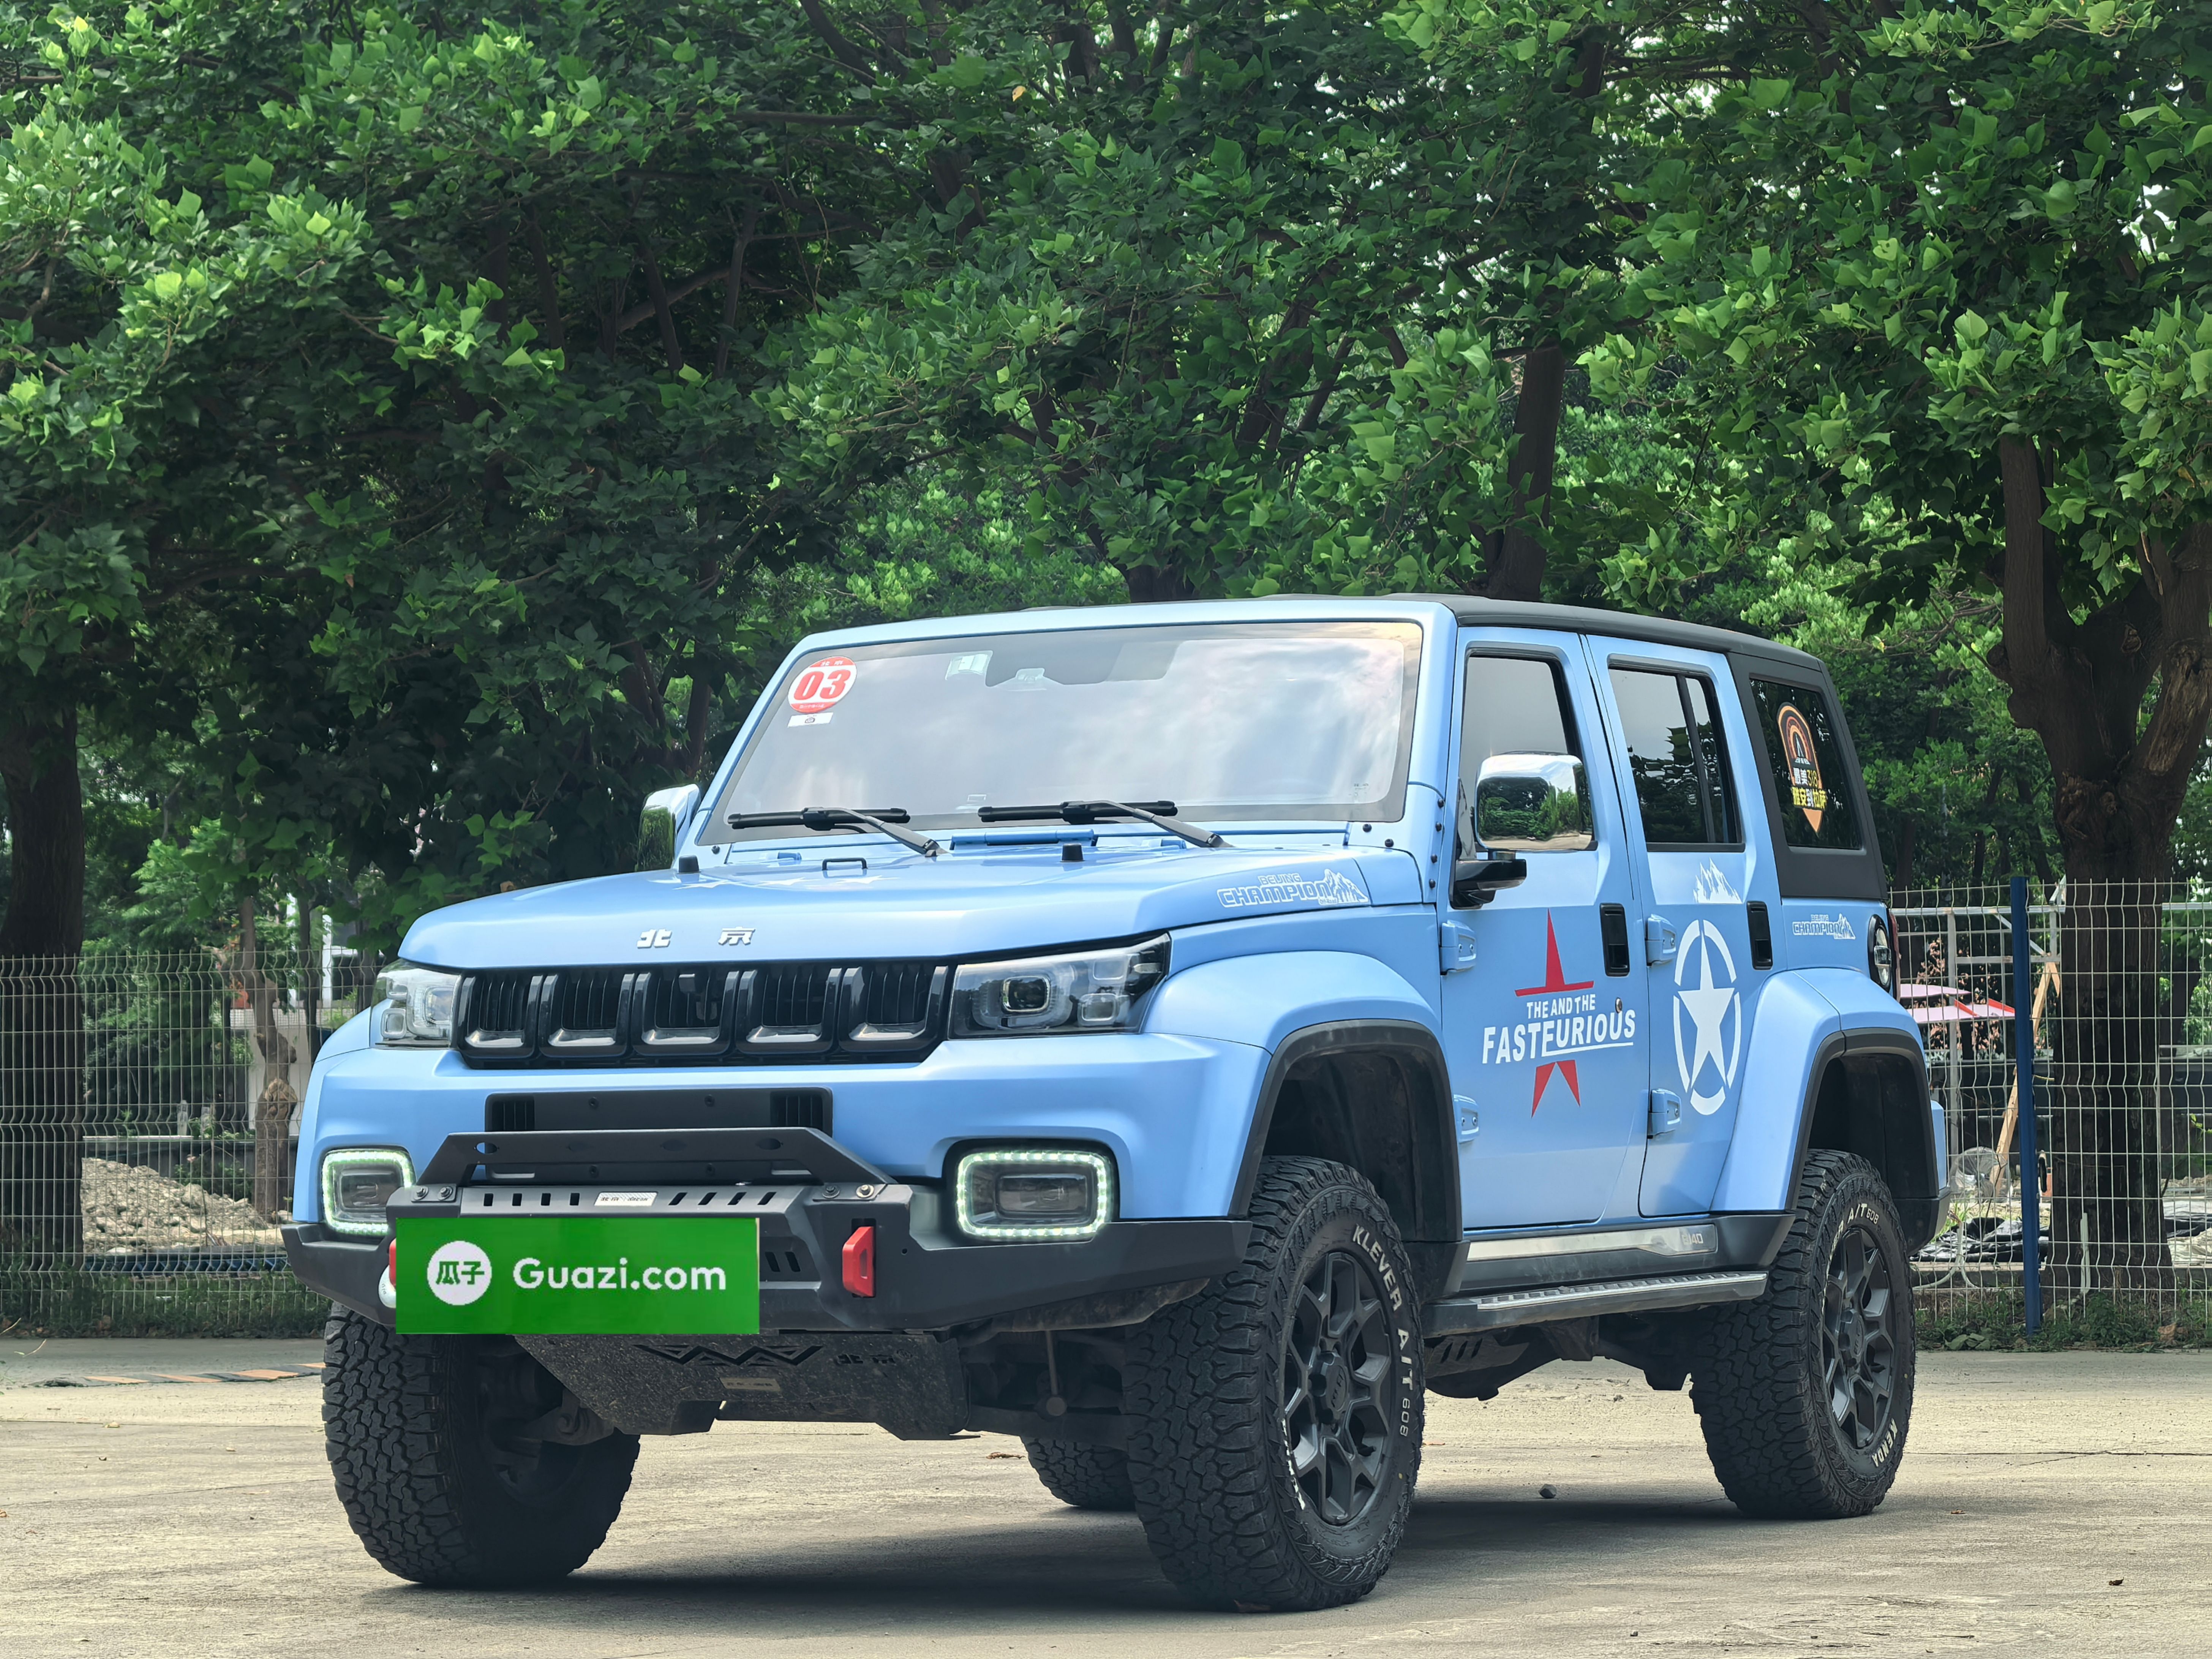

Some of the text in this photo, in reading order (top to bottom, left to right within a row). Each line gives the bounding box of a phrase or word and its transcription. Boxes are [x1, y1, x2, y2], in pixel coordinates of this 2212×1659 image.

[793, 669, 851, 700] 03
[1258, 873, 1303, 886] BEIJING
[1217, 880, 1334, 908] CHAMPION
[1792, 921, 1842, 935] CHAMPION
[1526, 994, 1596, 1019] THE AND THE
[1847, 1203, 1879, 1224] A/T 608
[1352, 1223, 1402, 1311] KLEVER
[1400, 1398, 1410, 1437] 608
[1871, 1418, 1898, 1467] KENDA
